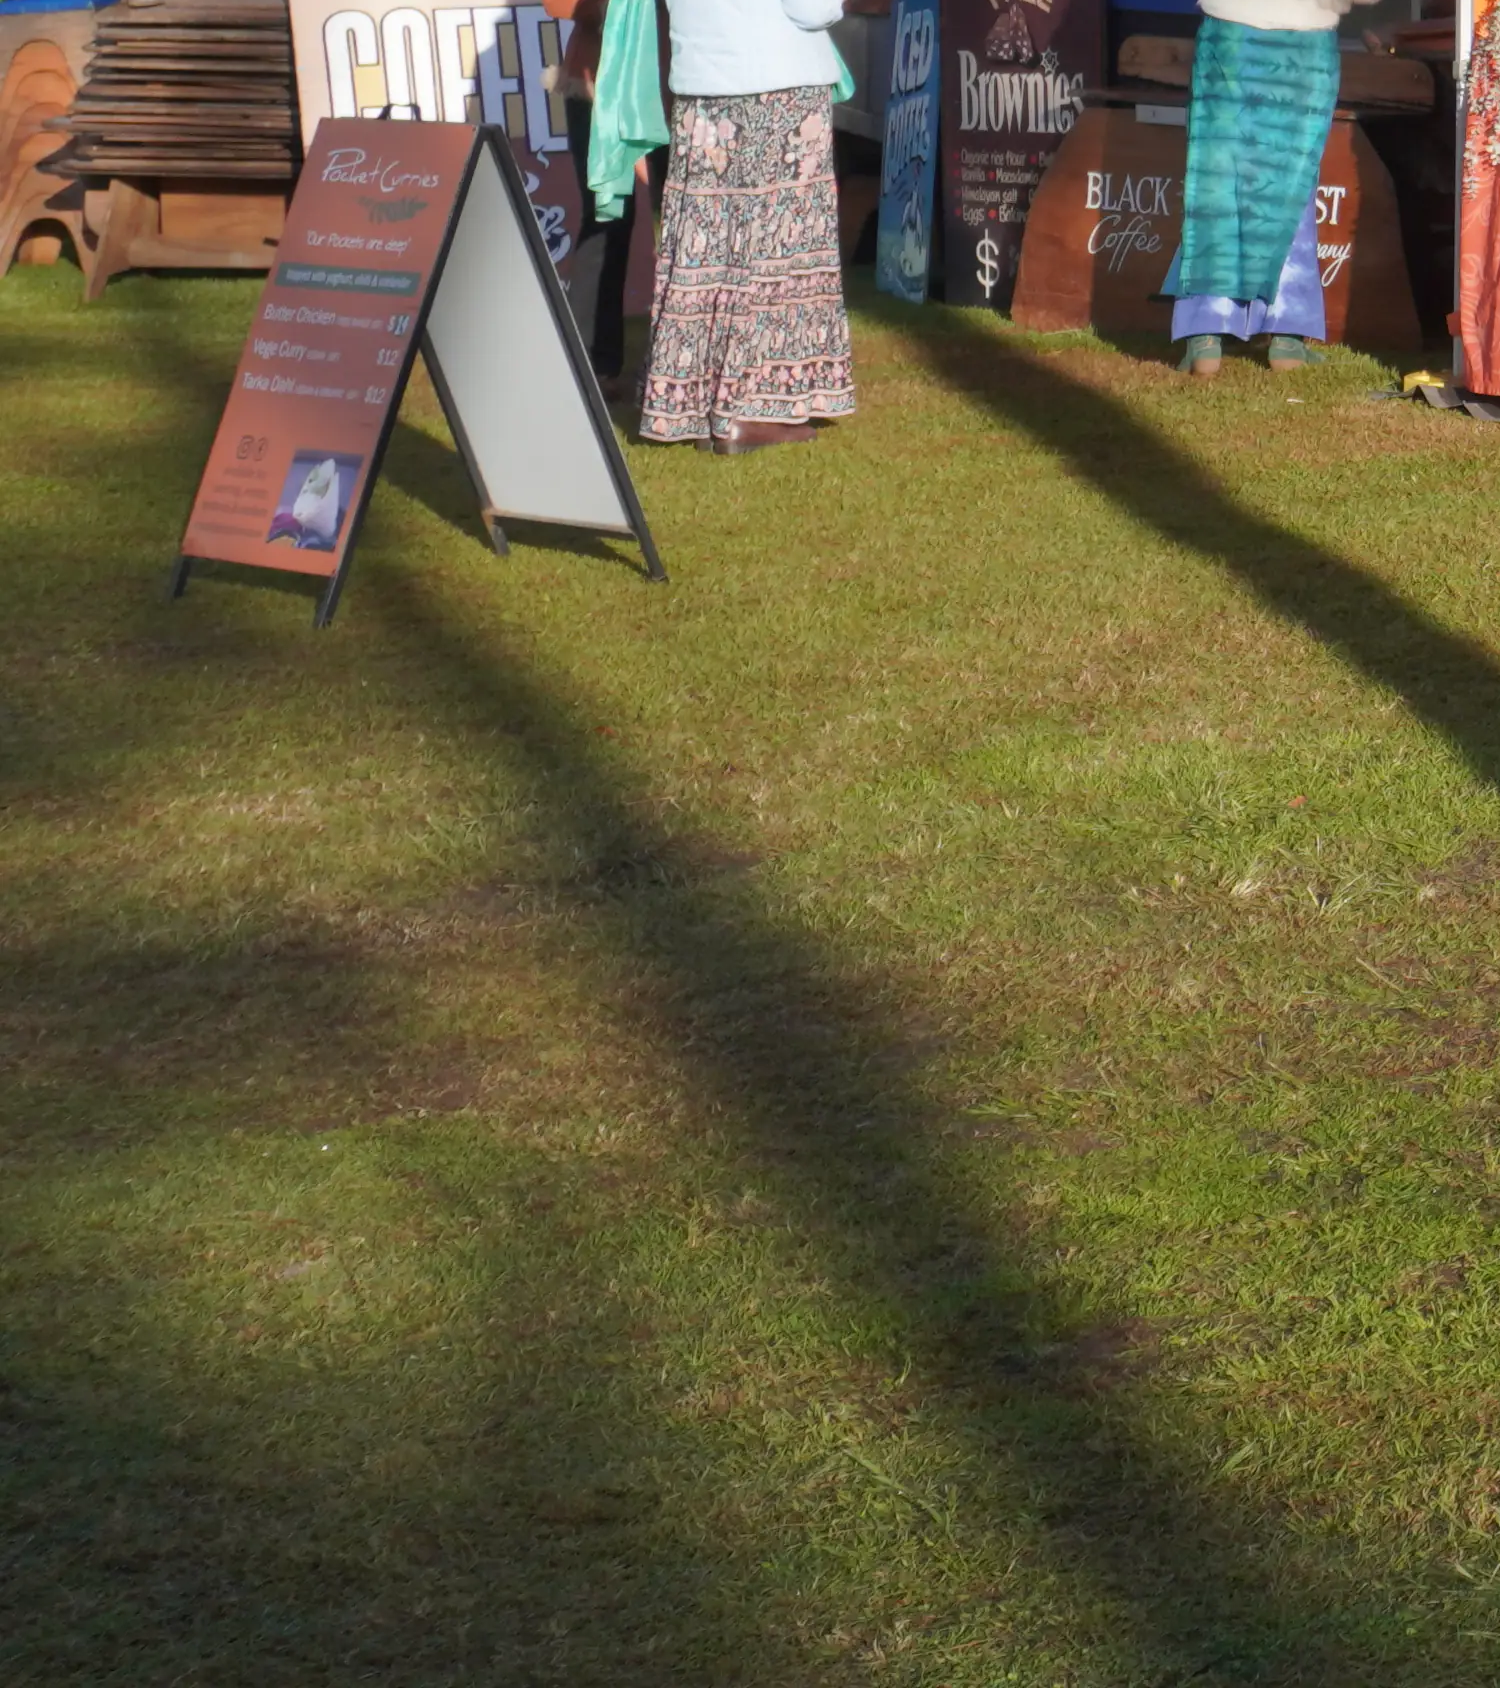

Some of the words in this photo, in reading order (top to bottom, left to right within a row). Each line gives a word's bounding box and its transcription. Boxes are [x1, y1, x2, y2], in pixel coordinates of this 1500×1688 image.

[890, 2, 935, 97] ICED
[957, 49, 1085, 134] Brownies
[961, 149, 989, 168] Organic
[322, 148, 380, 185] Pocket
[380, 161, 439, 193] Curries
[1085, 171, 1171, 216] BLACK
[962, 206, 985, 226] Eggs
[327, 234, 364, 250] Pockets
[366, 238, 384, 251] are
[1087, 214, 1163, 272] Coffee
[1317, 242, 1351, 287] any
[976, 228, 1000, 299] $
[263, 303, 296, 322] Butter
[296, 306, 336, 325] Chicken
[254, 338, 279, 359] Vege
[279, 340, 307, 361] Curry
[376, 348, 399, 366] $12
[242, 372, 269, 391] Tarka
[363, 385, 386, 404] $12
